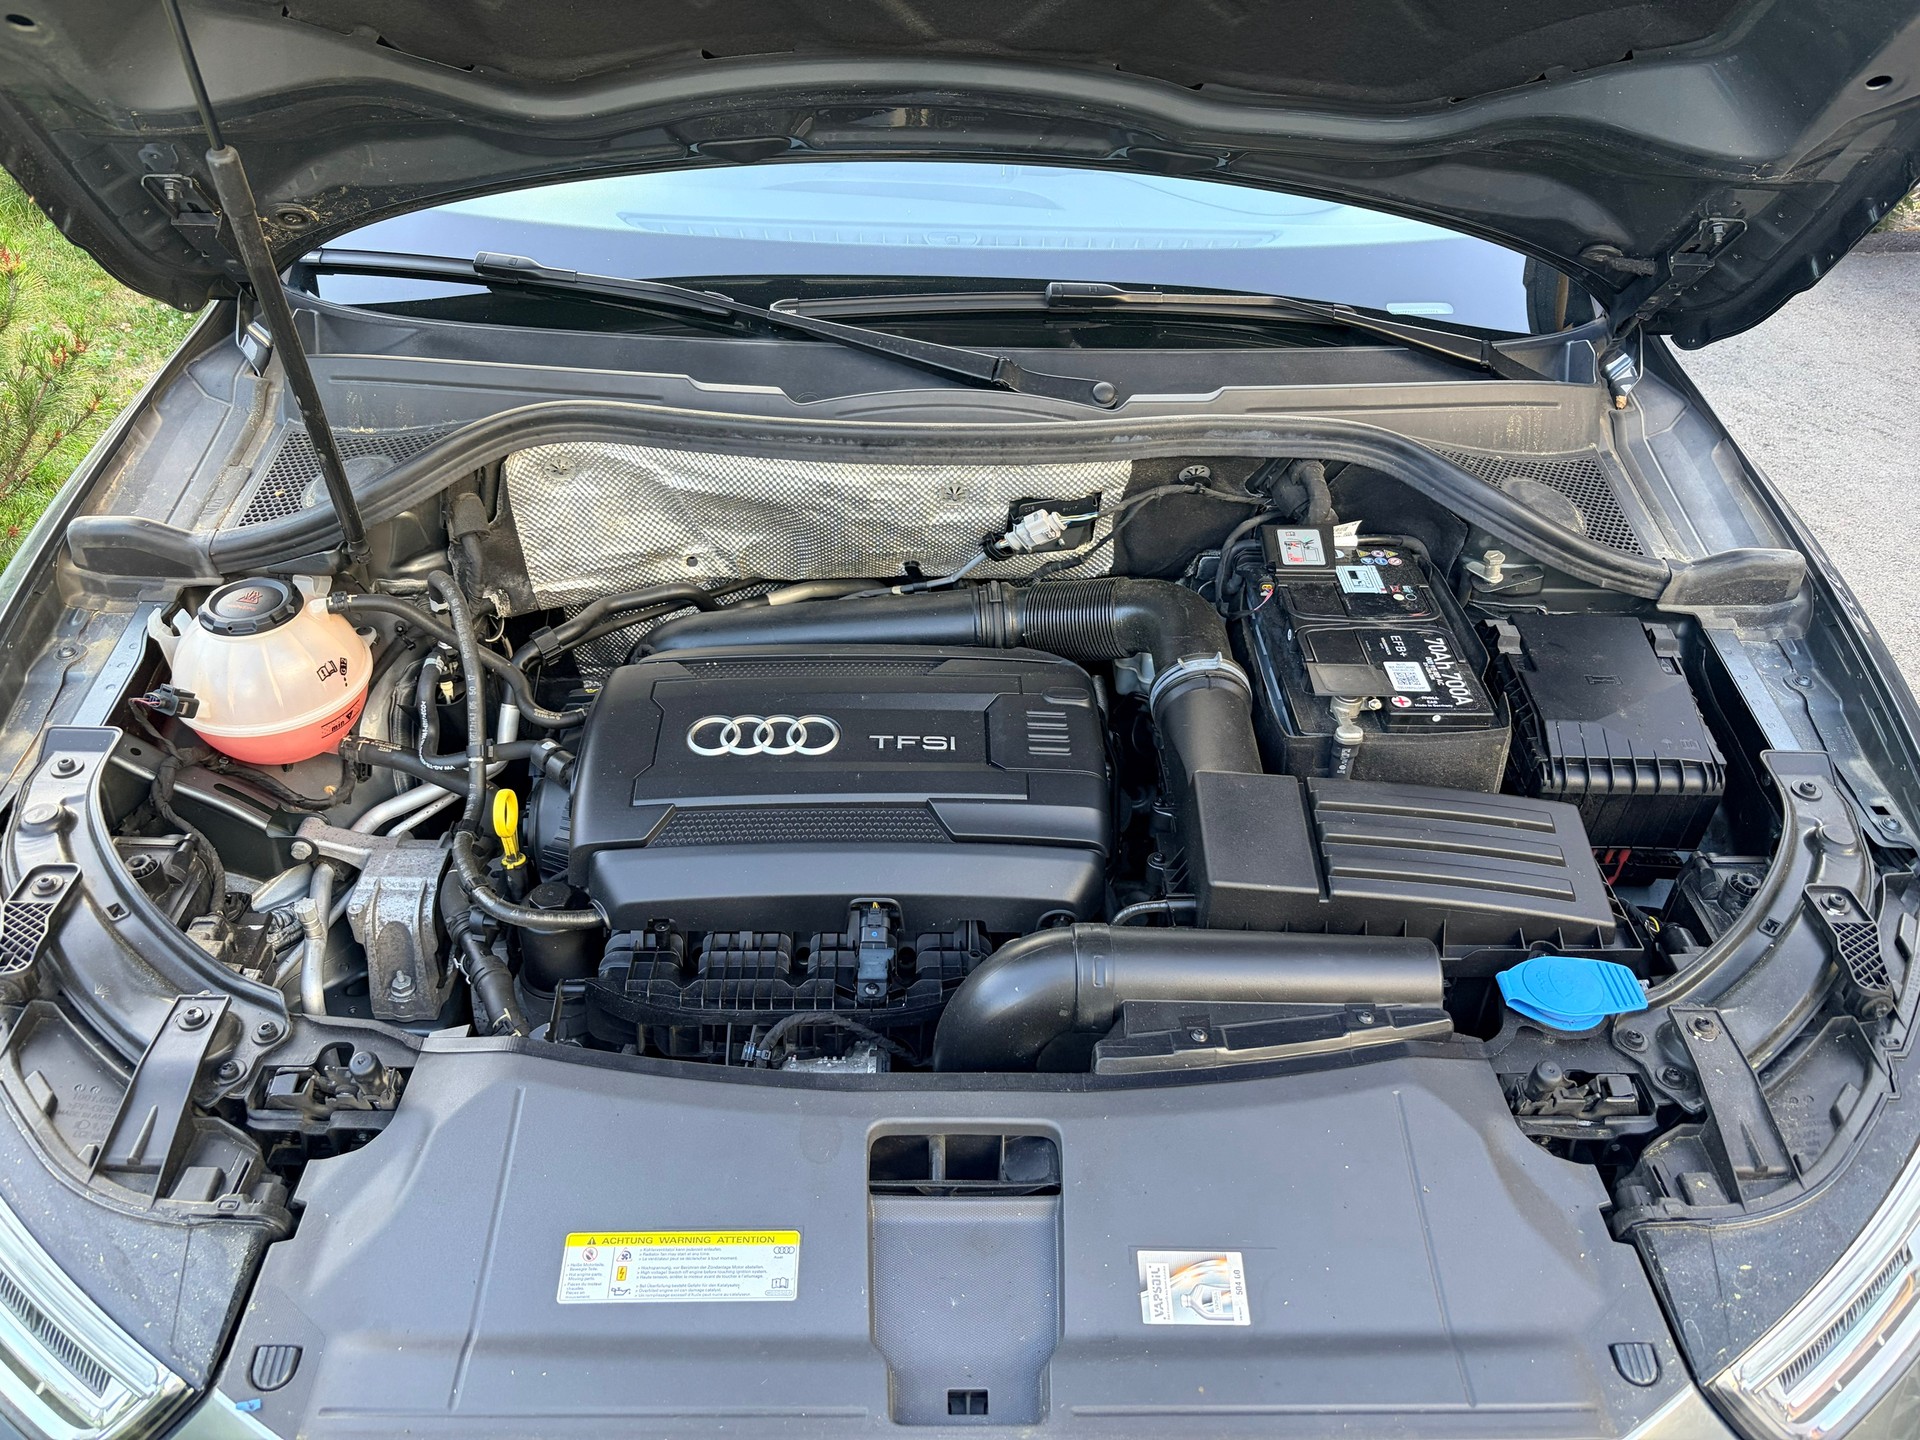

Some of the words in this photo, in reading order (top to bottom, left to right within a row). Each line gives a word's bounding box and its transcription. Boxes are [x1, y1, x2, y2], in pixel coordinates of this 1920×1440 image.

[1390, 635, 1407, 657] EFB+
[1424, 637, 1454, 670] 70Ah
[1441, 672, 1474, 706] 700A
[331, 720, 345, 732] min
[869, 735, 956, 752] TFSI
[602, 1236, 653, 1245] ACHTUNG
[659, 1236, 711, 1244] WARNING
[716, 1235, 775, 1244] ATTENTION
[1235, 1281, 1243, 1295] 504
